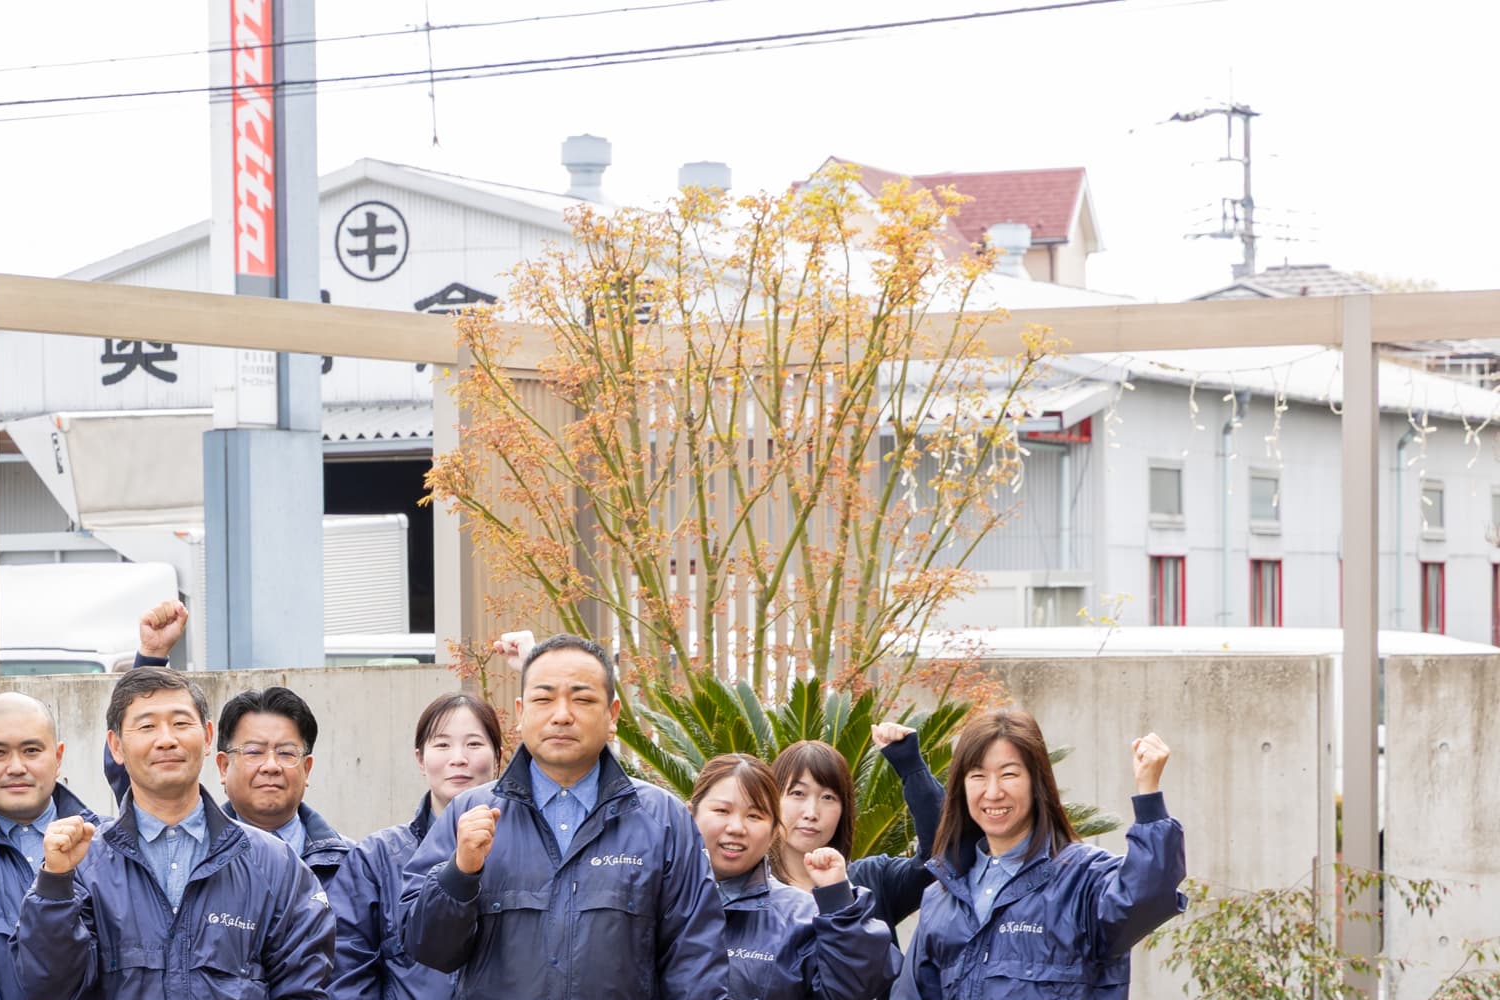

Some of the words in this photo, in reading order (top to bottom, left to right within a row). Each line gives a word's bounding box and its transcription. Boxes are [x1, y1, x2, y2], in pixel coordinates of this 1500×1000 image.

[602, 853, 644, 866] Kalmia
[1006, 920, 1044, 934] Kalmia
[734, 948, 775, 961] Kalmia
